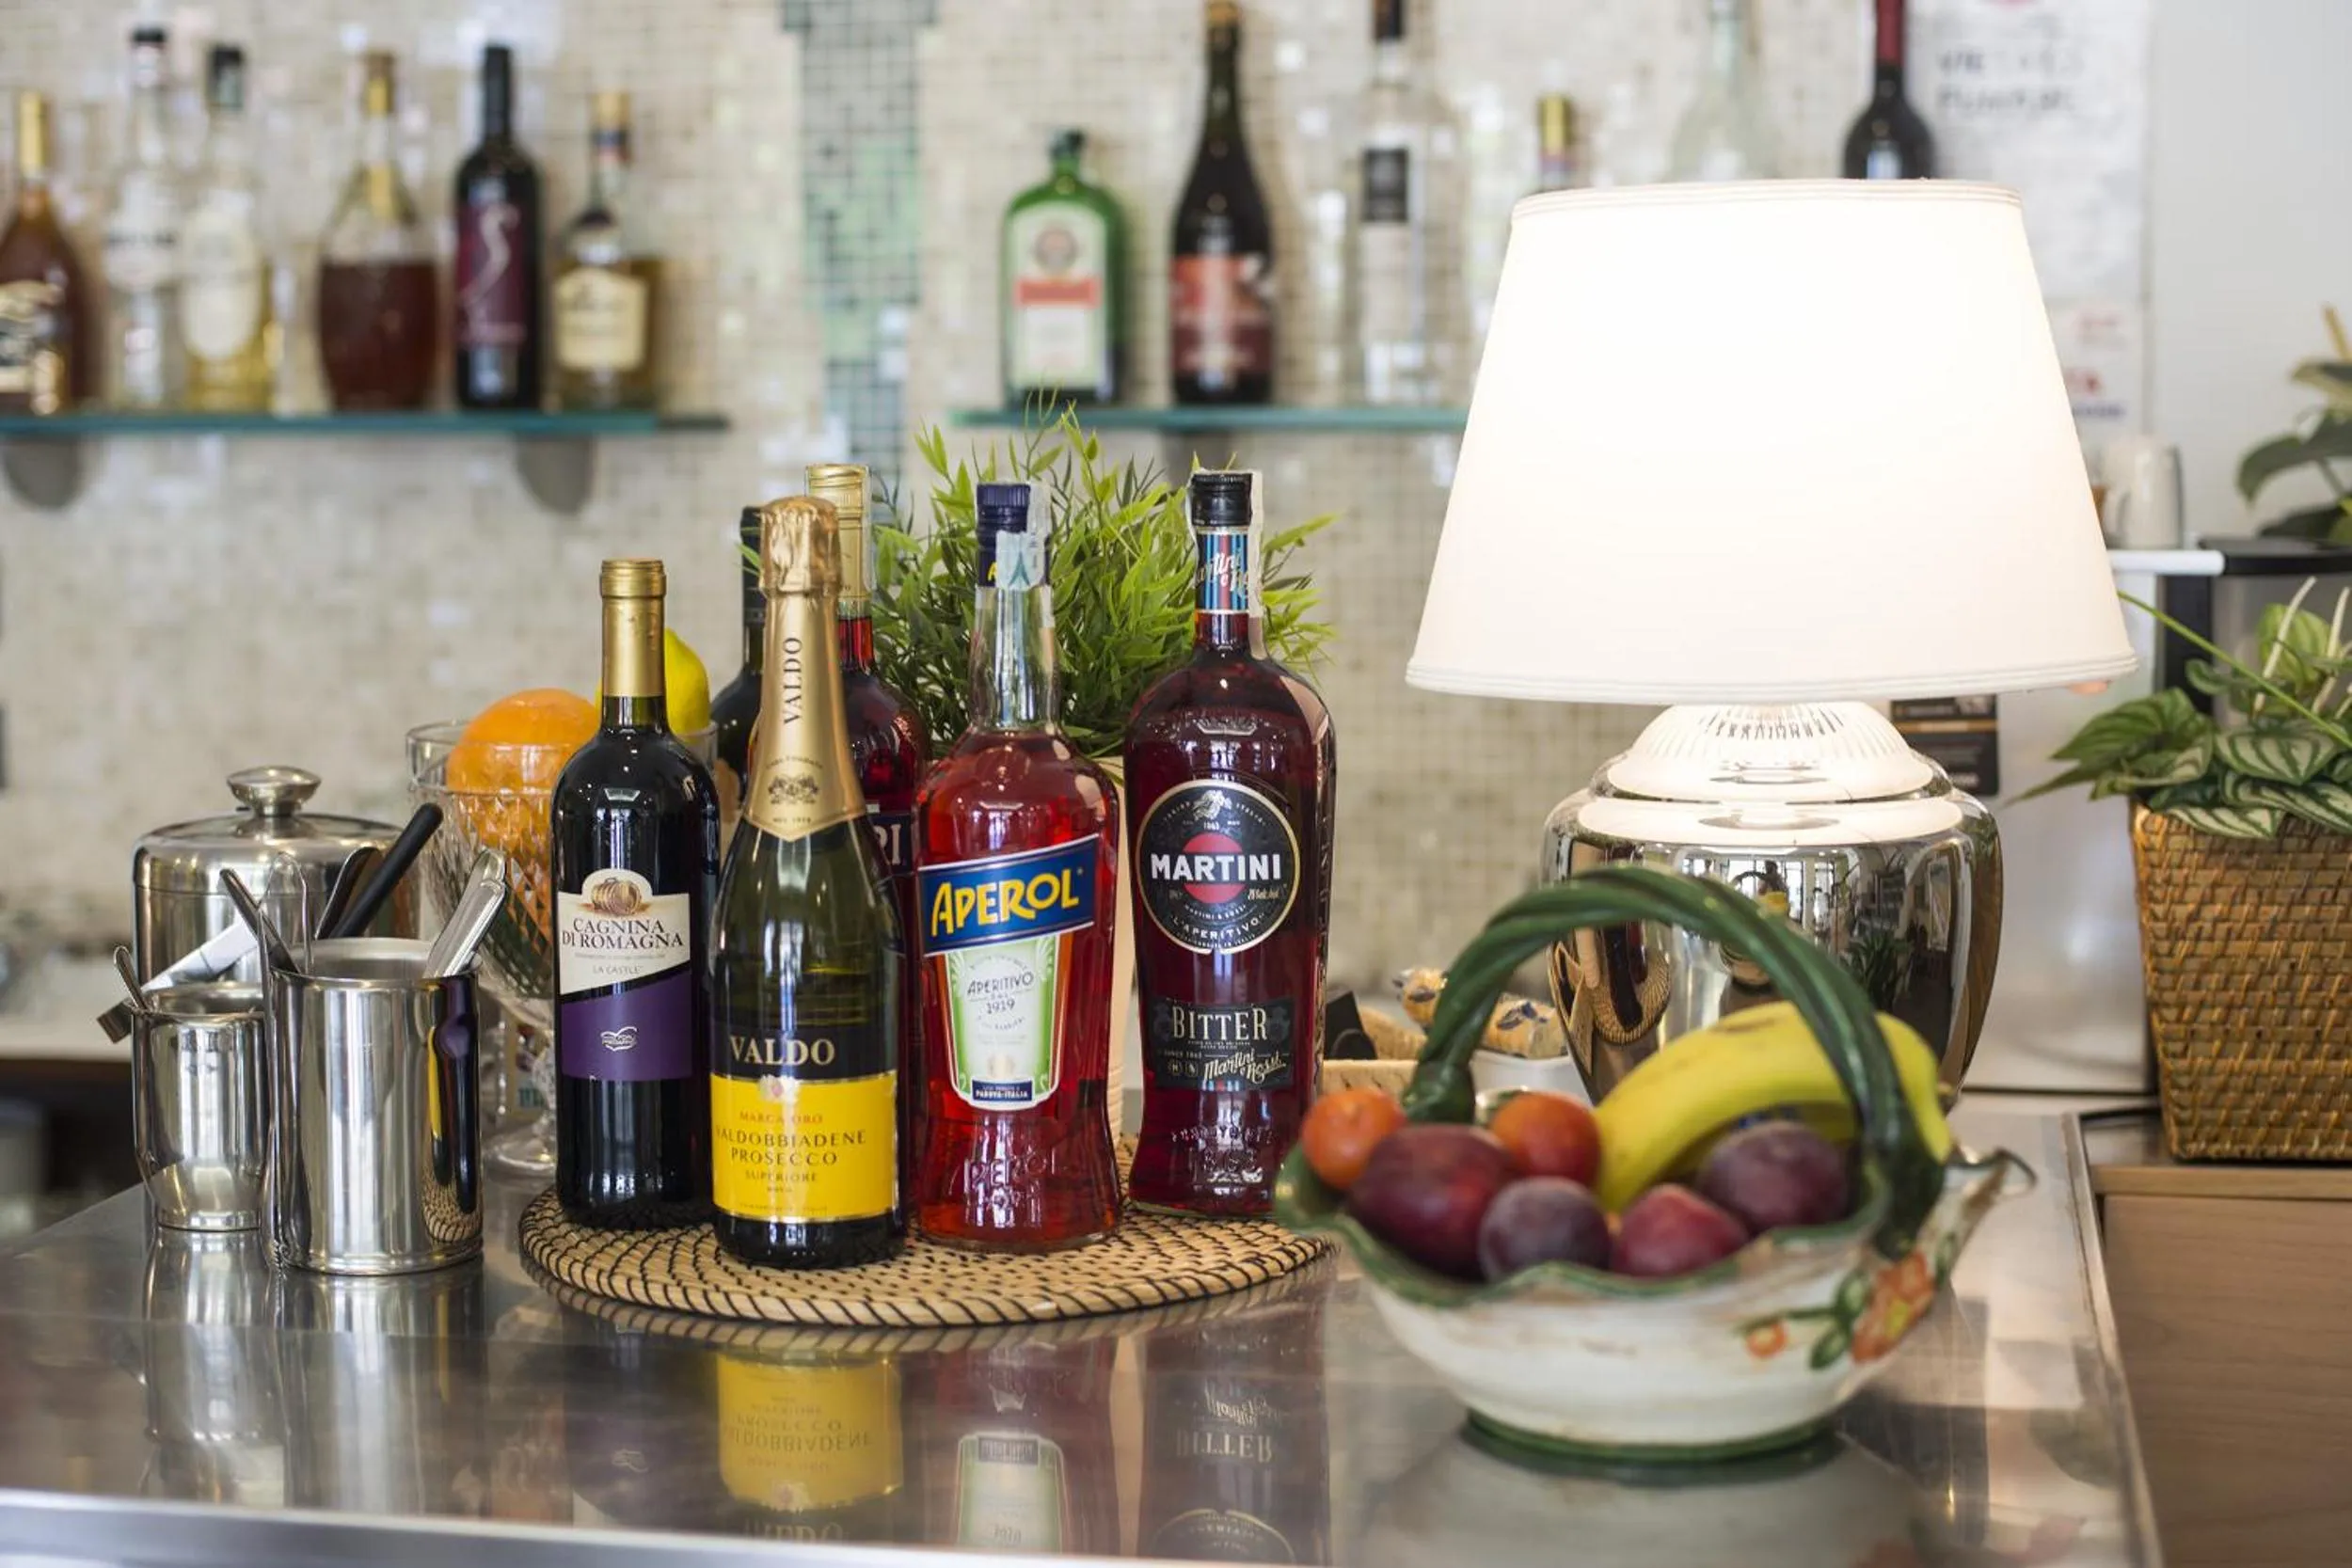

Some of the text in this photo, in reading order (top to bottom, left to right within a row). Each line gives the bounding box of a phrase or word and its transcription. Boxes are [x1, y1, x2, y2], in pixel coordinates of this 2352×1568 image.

[783, 637, 803, 724] VALDO
[1151, 853, 1281, 882] MARTINI
[930, 868, 1079, 937] APEROL
[562, 930, 684, 949] DI ROMAGNA
[573, 917, 664, 934] CAGNINA
[967, 971, 1034, 994] APERITIVO
[986, 998, 1015, 1014] 1919
[1172, 1006, 1267, 1040] BITTER
[729, 1037, 834, 1066] VALDO
[1202, 1048, 1256, 1081] Martini
[731, 1148, 837, 1166] PROSECCO
